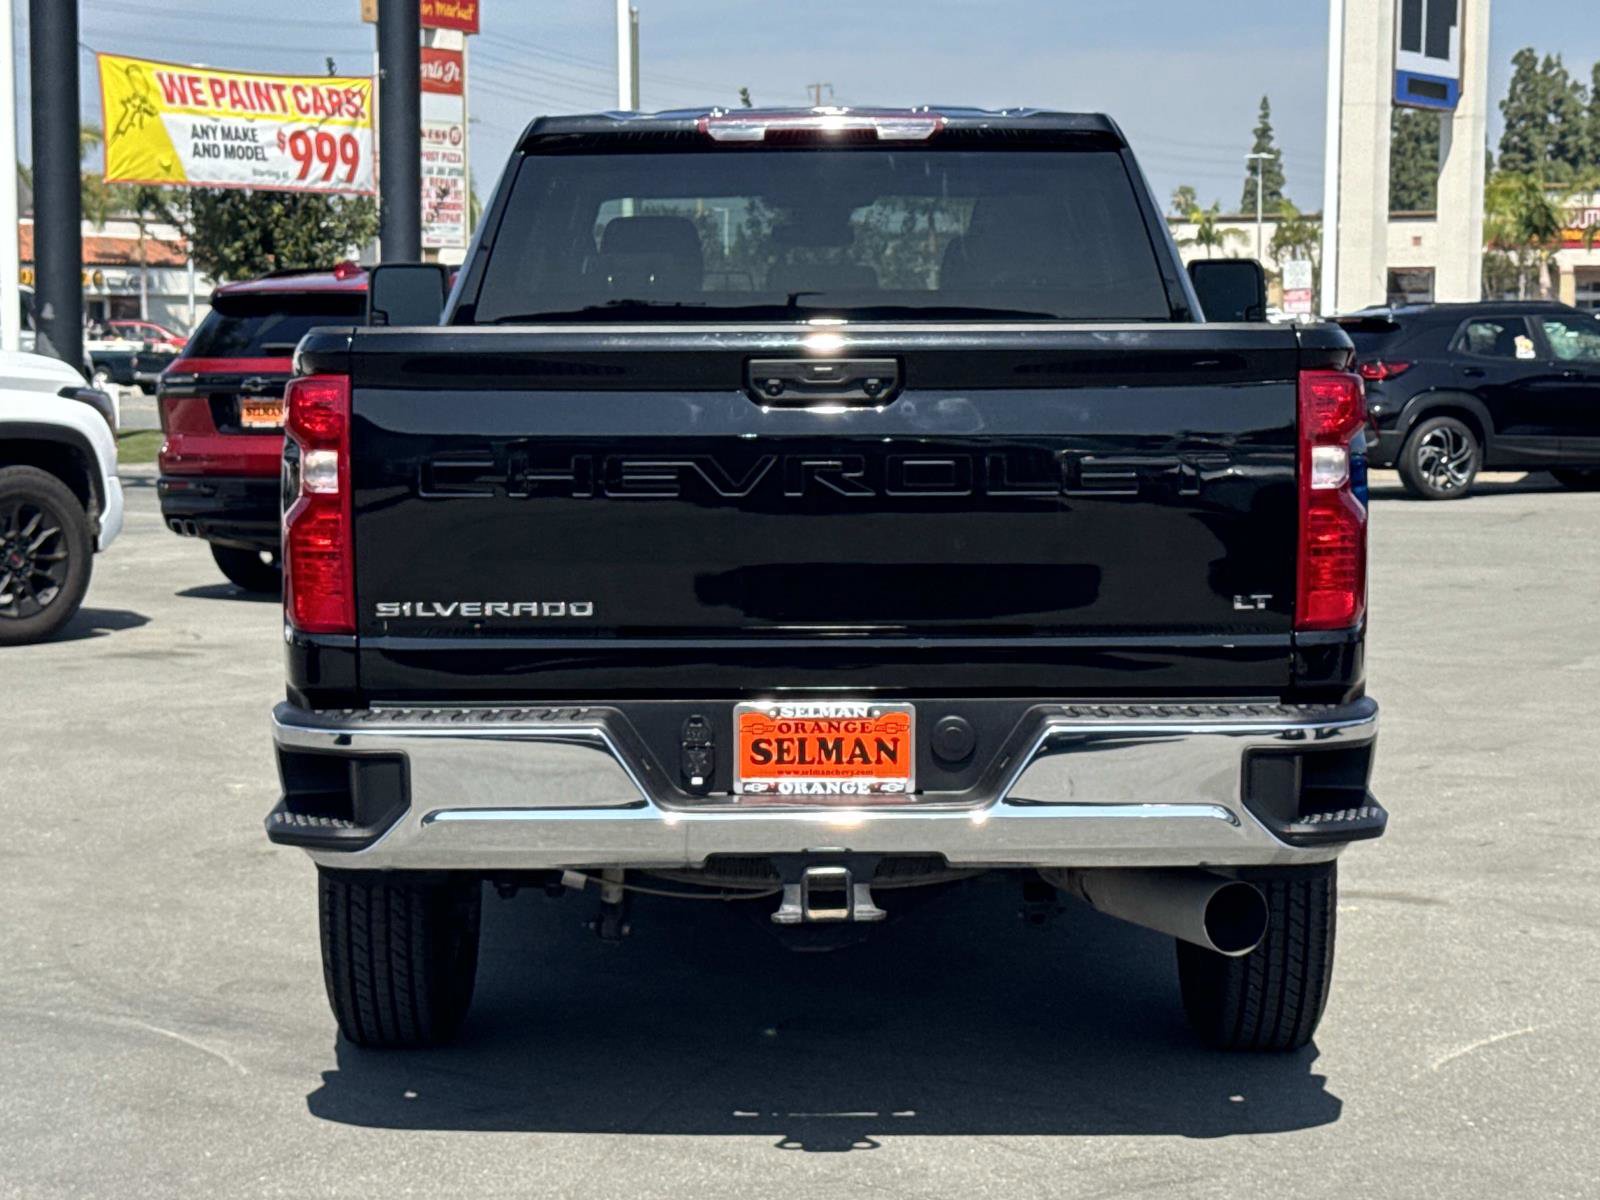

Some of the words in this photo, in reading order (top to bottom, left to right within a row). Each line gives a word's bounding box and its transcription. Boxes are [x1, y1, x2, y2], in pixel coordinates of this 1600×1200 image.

[156, 72, 209, 107] WE
[208, 78, 289, 113] PAINT
[291, 85, 366, 119] CARS!
[191, 123, 218, 141] ANY
[220, 125, 260, 143] MAKE
[192, 142, 221, 158] AND
[223, 144, 269, 161] MODEL
[276, 128, 360, 184] $999
[418, 452, 1232, 497] CHEVROLET
[375, 601, 594, 618] SILVERADO
[1233, 594, 1273, 610] LT
[778, 706, 869, 718] SELMAN
[777, 721, 873, 734] ORANGE
[750, 737, 900, 765] SELMAN
[778, 782, 871, 795] ORANGE
